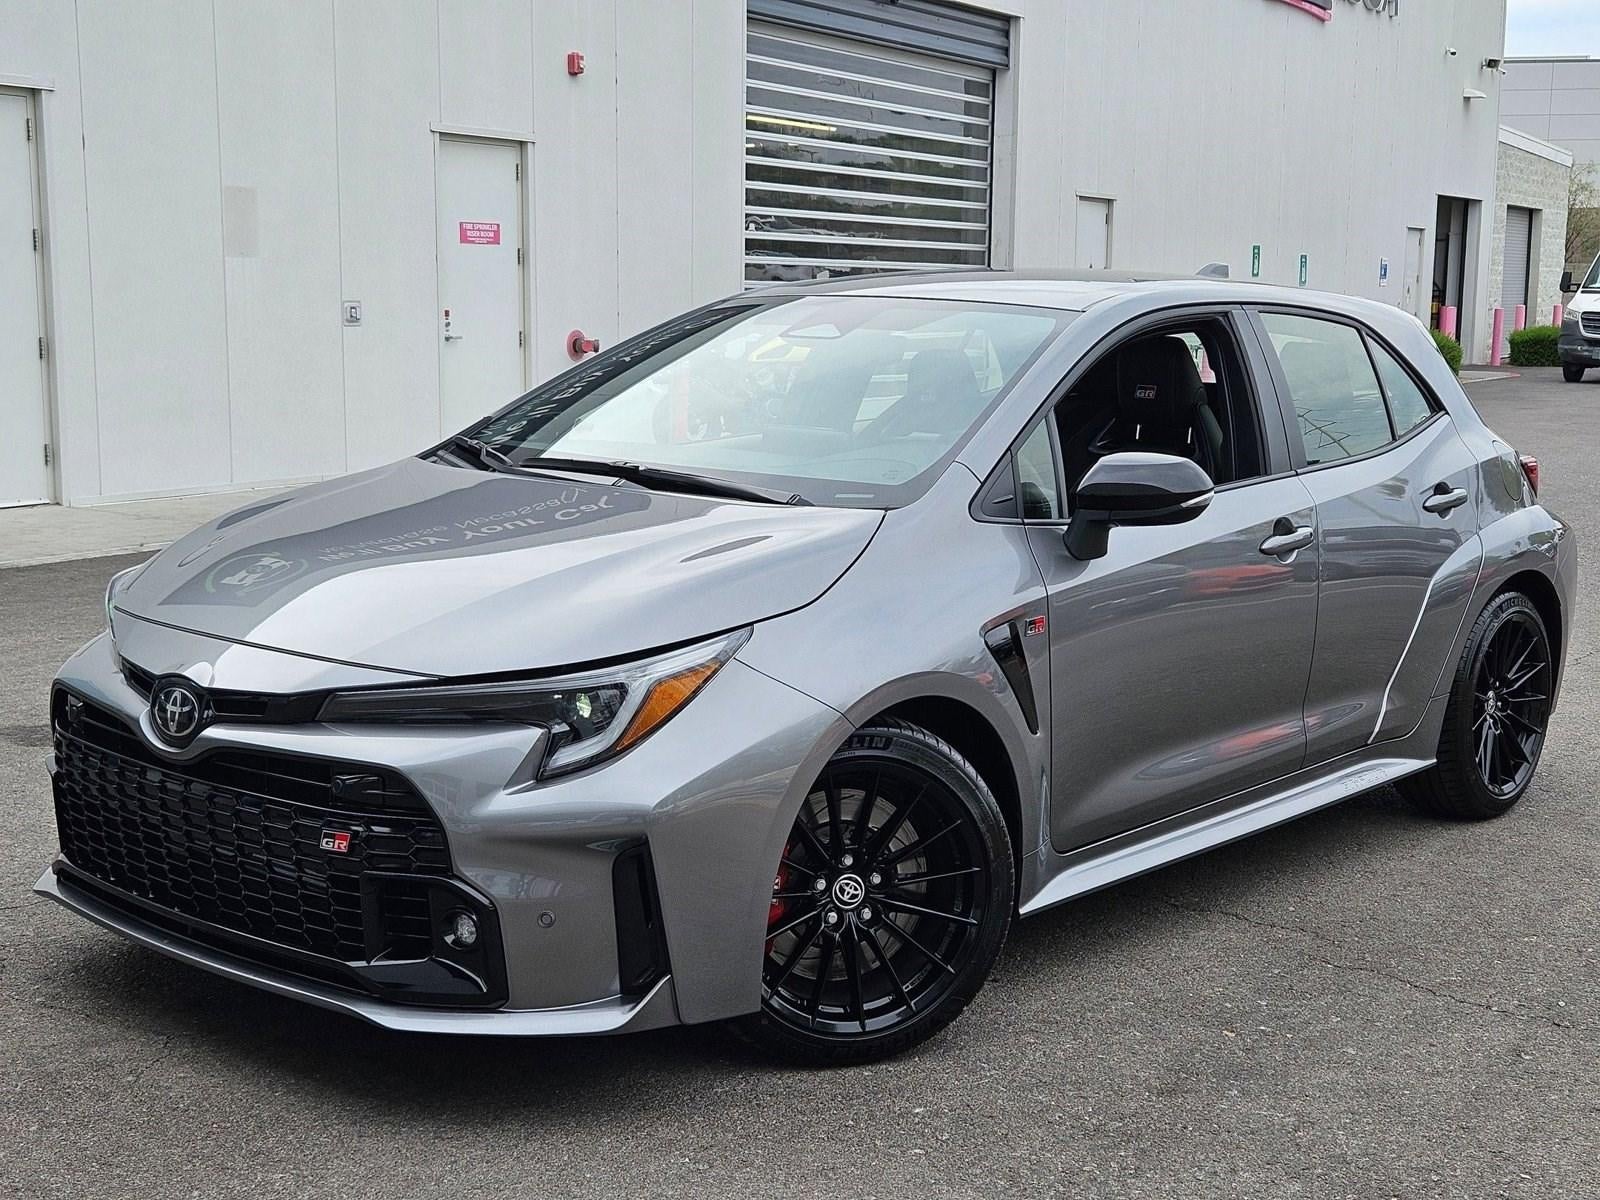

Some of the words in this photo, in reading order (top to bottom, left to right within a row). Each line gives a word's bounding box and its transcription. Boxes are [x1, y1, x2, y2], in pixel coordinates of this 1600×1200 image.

[1136, 389, 1154, 398] GR
[1027, 622, 1045, 634] GR
[321, 837, 348, 850] GR
